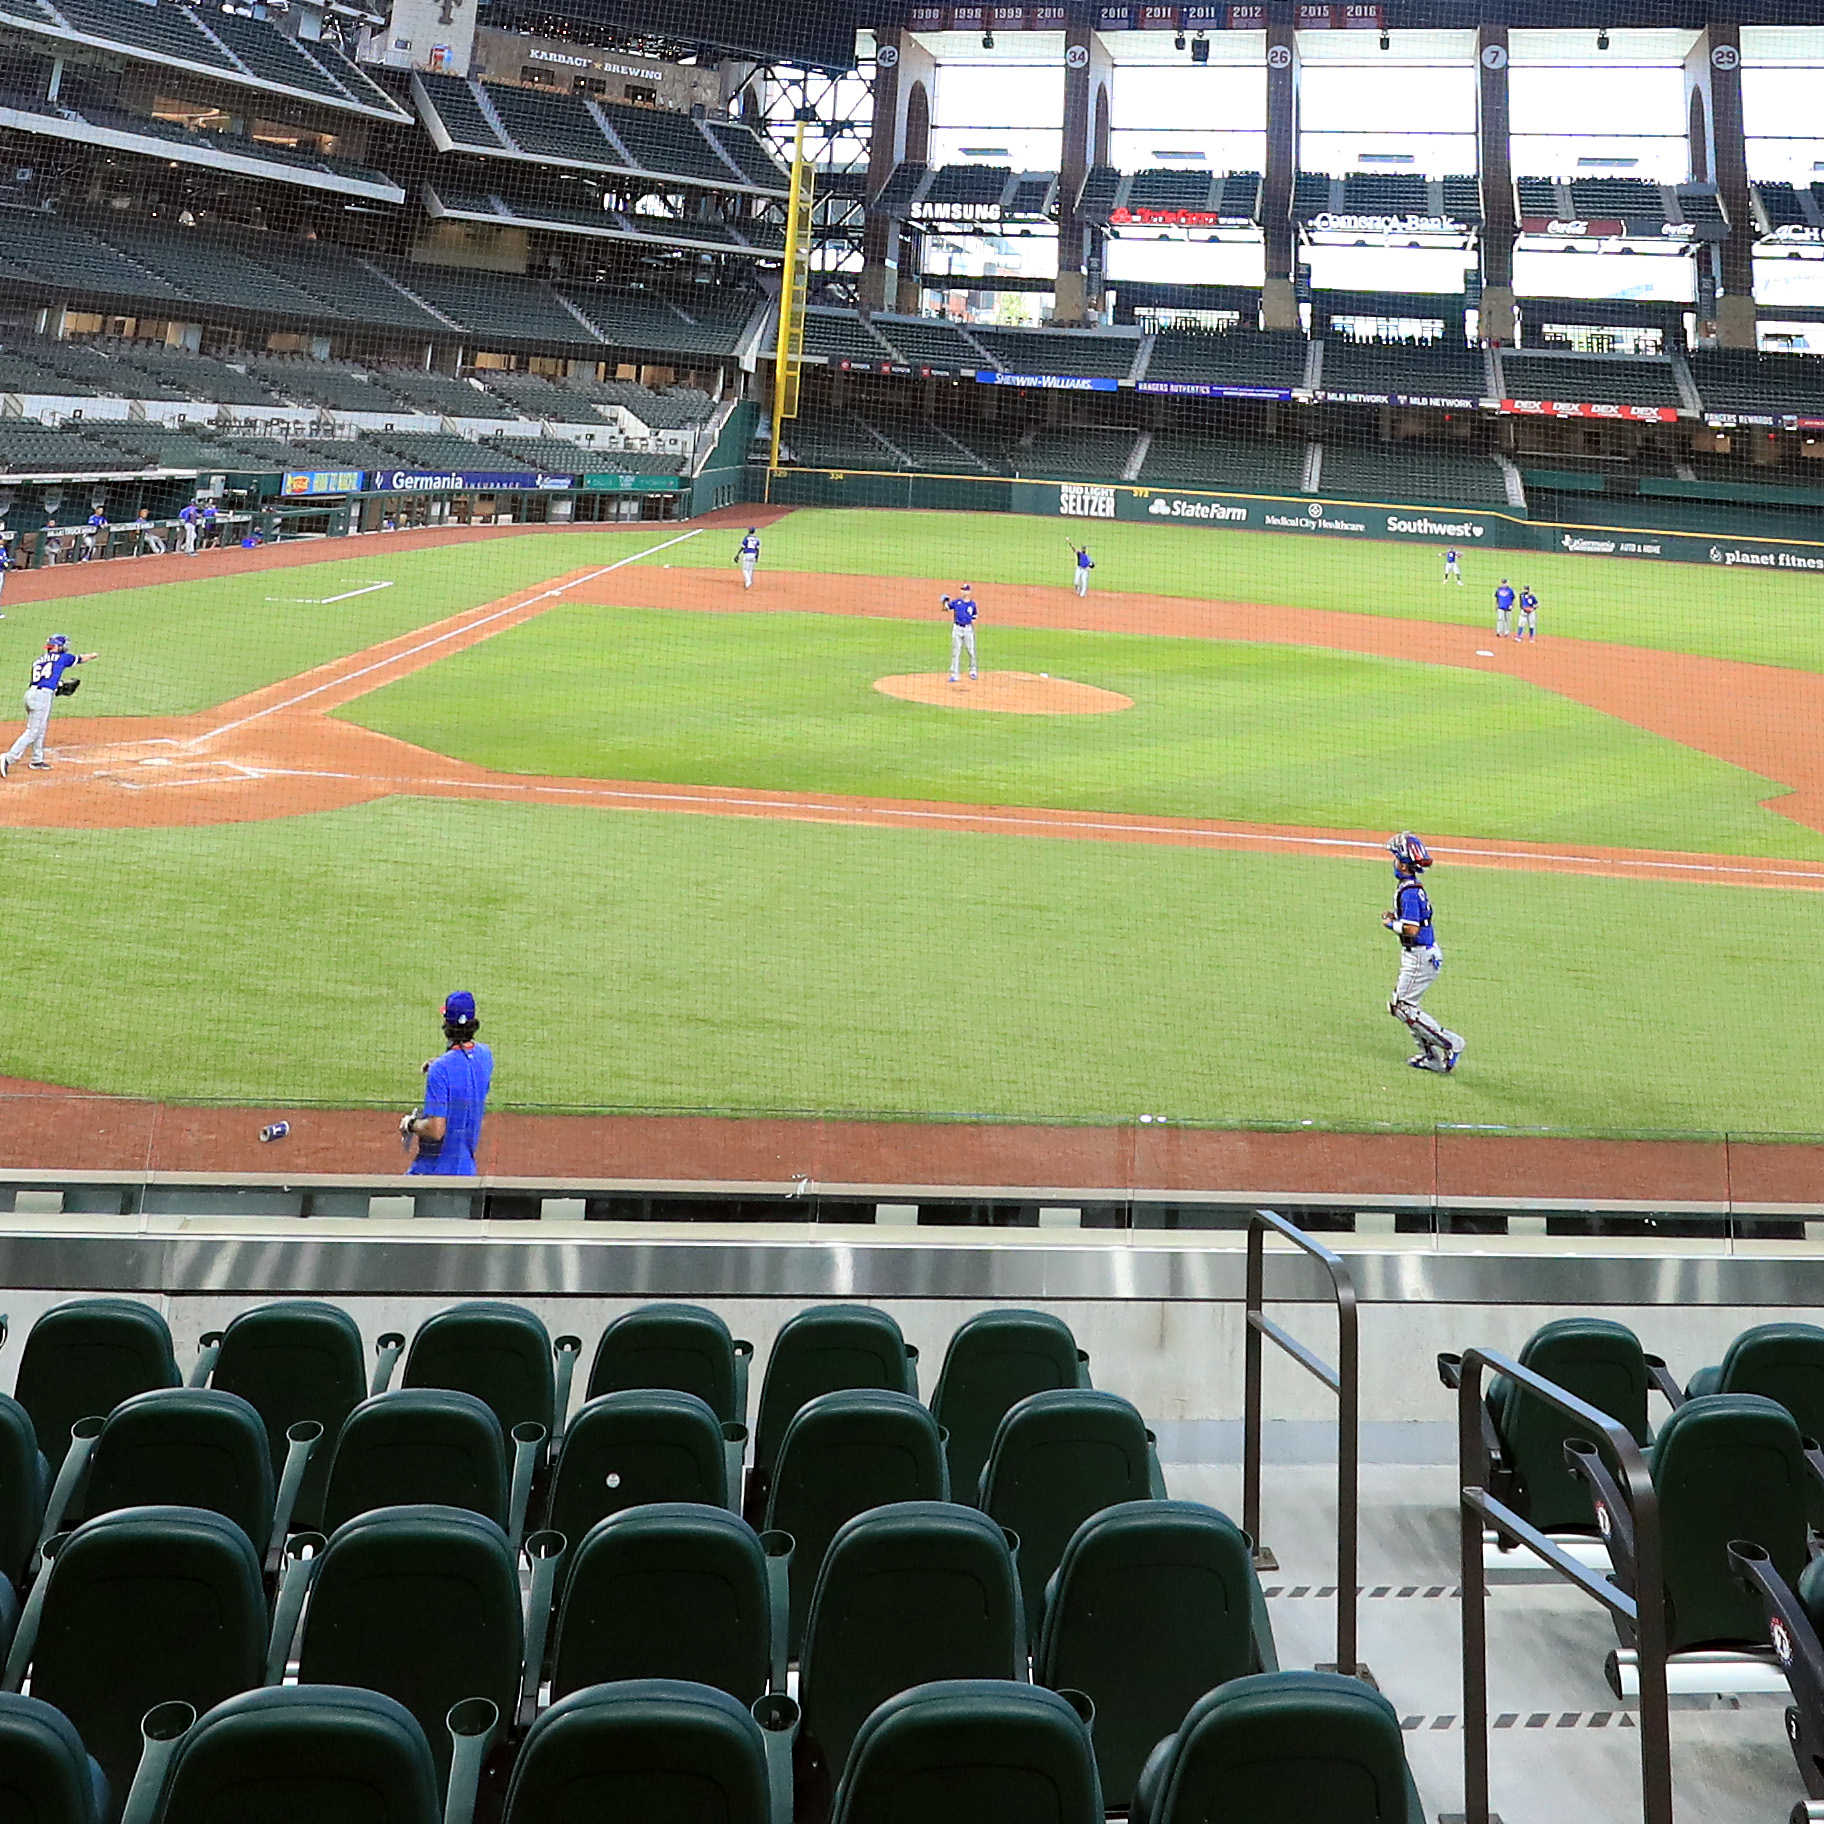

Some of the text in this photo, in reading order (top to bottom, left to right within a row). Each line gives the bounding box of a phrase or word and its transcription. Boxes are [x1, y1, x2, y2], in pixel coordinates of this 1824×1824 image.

[994, 7, 1022, 19] 1999
[1037, 7, 1064, 19] 2010
[1101, 7, 1128, 19] 2010
[1145, 7, 1172, 19] 2011
[1188, 7, 1216, 19] 2011
[1232, 6, 1262, 18] 2012
[1300, 6, 1330, 18] 2015
[1346, 5, 1376, 17] 2016
[878, 50, 896, 63] 42
[1068, 50, 1087, 63] 34
[1270, 50, 1289, 63] 26
[1490, 50, 1499, 64] 7
[1715, 50, 1736, 64] 29
[604, 62, 662, 80] BREWING
[910, 202, 1001, 220] SAMSUNG
[1405, 214, 1455, 231] Bank
[1327, 392, 1389, 404] MLB NETWORK
[1409, 396, 1473, 408] MLB NETWORK
[1514, 400, 1542, 409] DEX
[1552, 402, 1581, 411] DEX
[1591, 404, 1620, 414] DEX
[1630, 407, 1659, 416] DEX
[392, 471, 464, 489] Germania
[1061, 484, 1116, 497] BUD LIGHT
[1133, 489, 1149, 498] 372
[1060, 494, 1116, 518] SELTZER
[1265, 514, 1366, 532] Medical City Healthcare
[1387, 516, 1473, 537] Southwest
[1725, 550, 1776, 569] planet
[32, 661, 53, 683] 64
